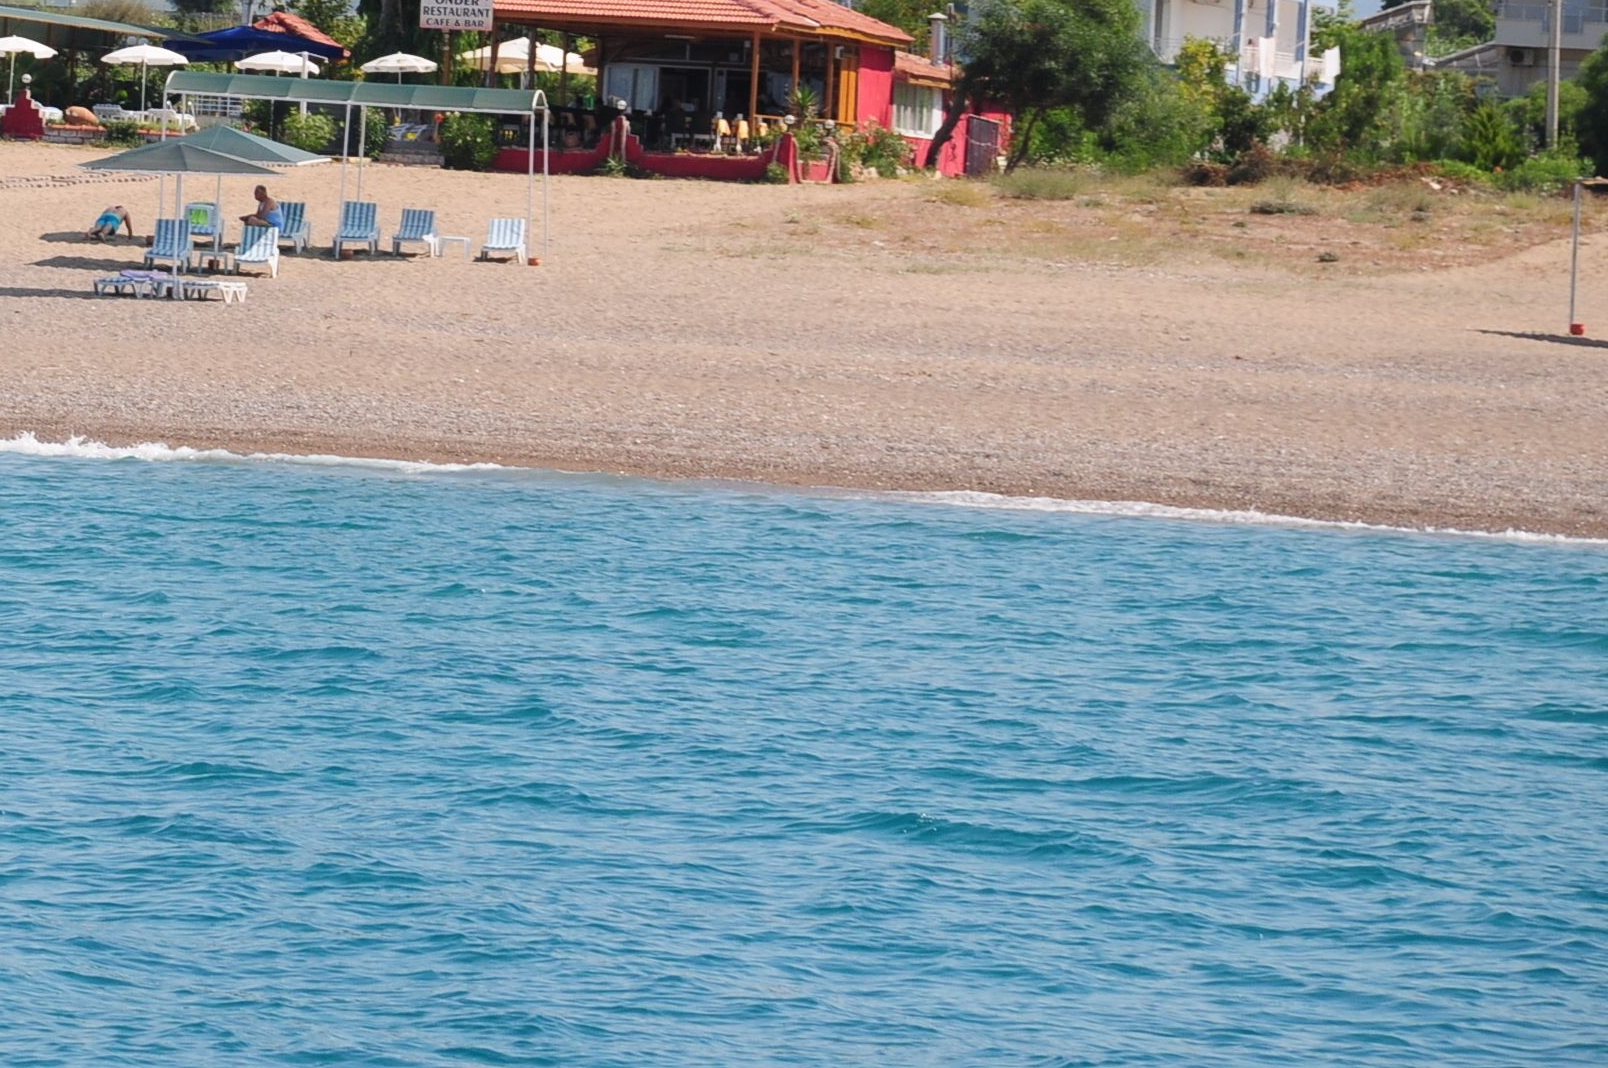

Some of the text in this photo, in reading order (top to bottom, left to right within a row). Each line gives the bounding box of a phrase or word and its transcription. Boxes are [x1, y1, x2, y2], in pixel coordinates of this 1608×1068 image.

[423, 6, 490, 17] RESTAURANT
[426, 18, 484, 28] CAFE & BAR
